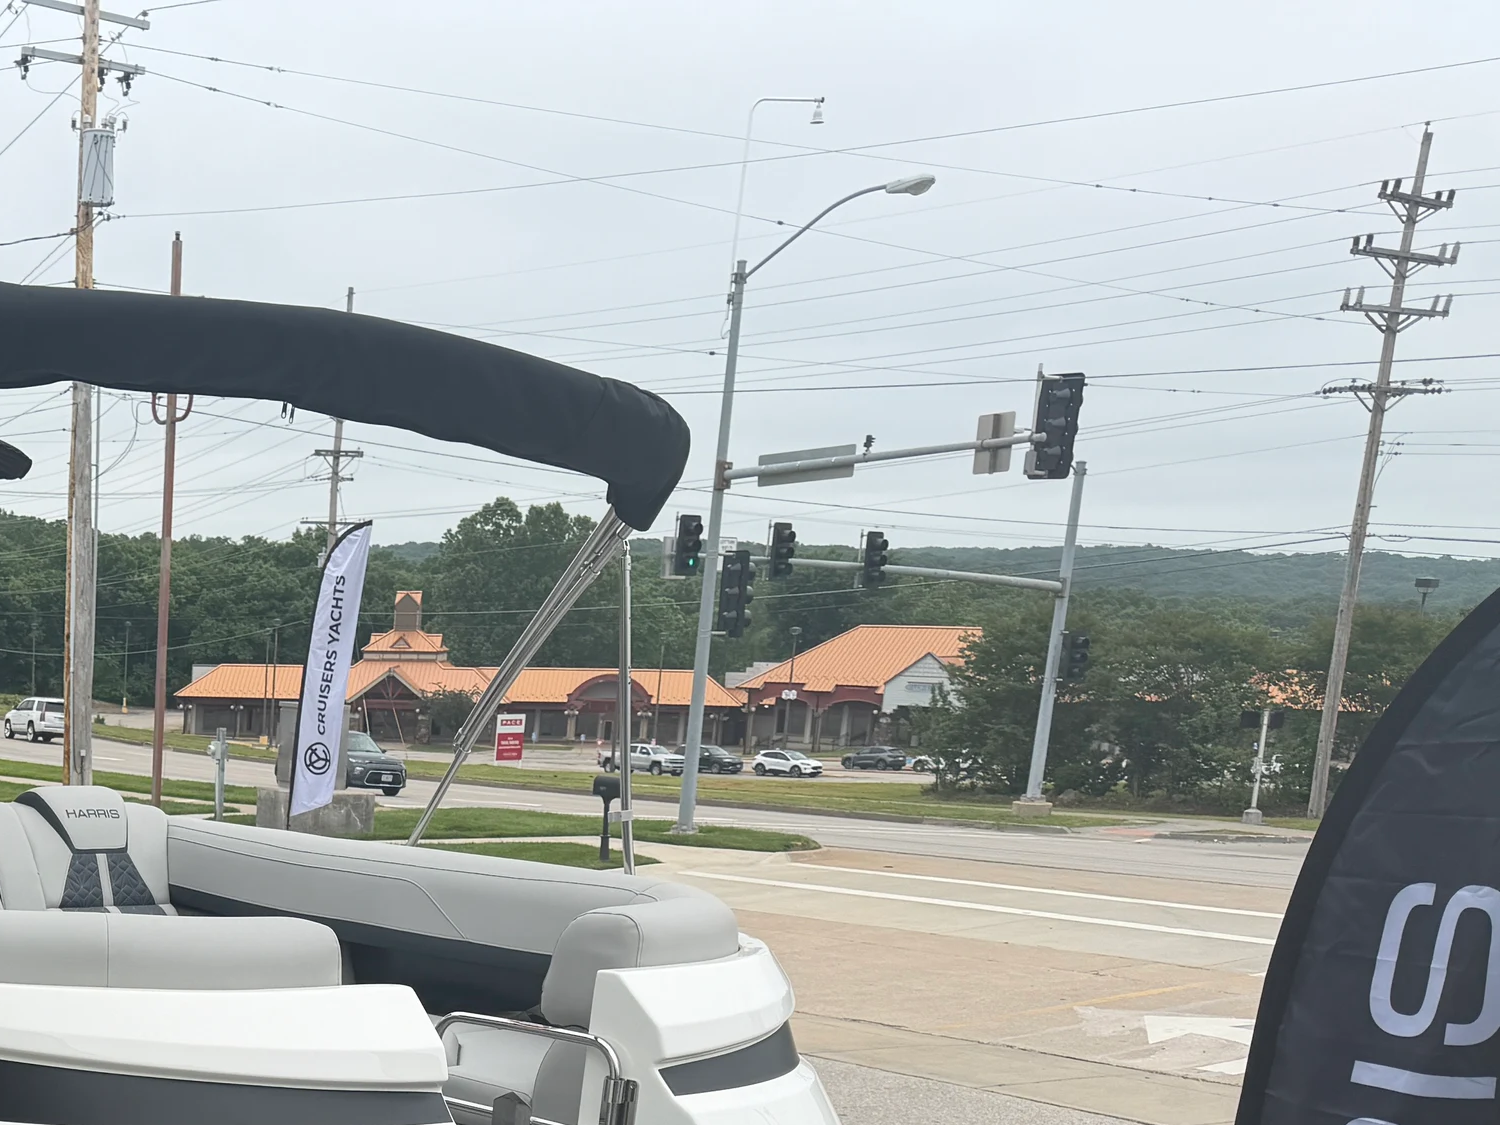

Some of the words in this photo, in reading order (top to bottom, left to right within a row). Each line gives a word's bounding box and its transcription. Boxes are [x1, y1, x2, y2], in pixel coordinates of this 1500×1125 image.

[327, 575, 346, 647] YACHTS
[317, 649, 338, 736] CRUISERS
[65, 808, 120, 819] HARRIS
